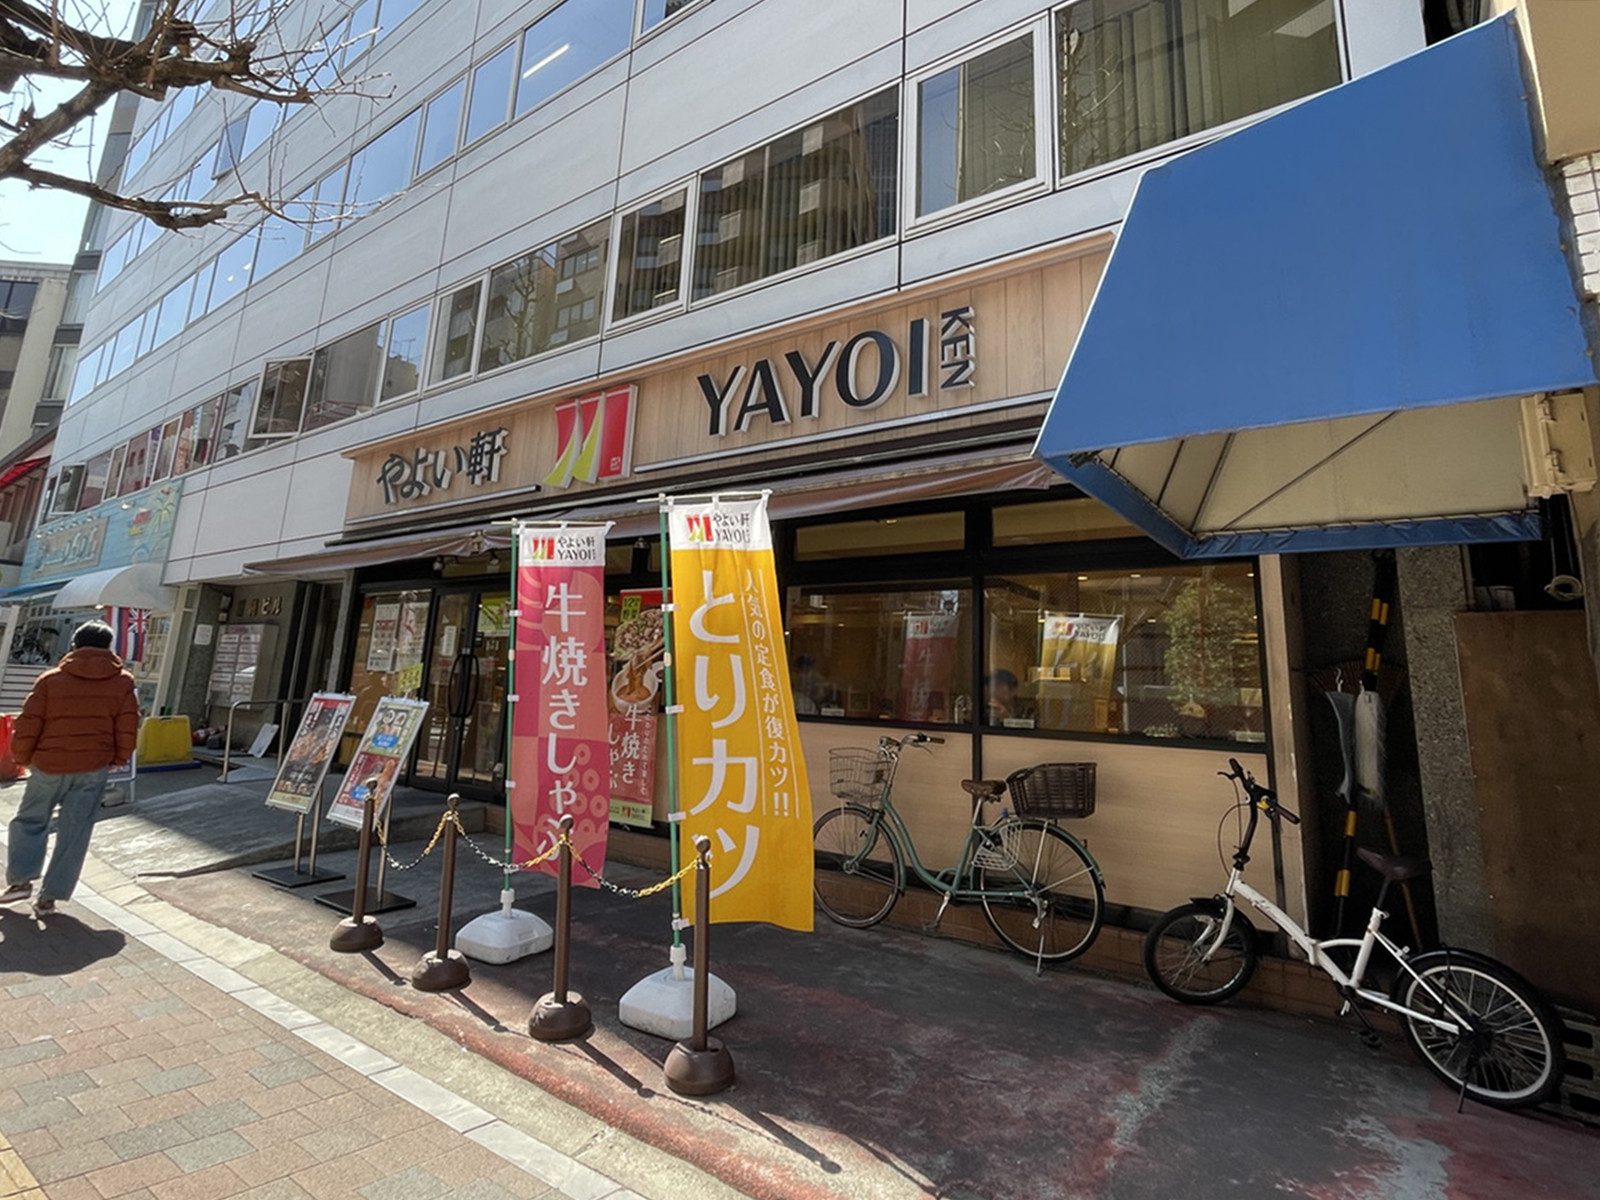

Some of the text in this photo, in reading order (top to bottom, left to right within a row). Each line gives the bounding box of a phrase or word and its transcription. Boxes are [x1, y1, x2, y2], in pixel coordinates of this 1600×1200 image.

[696, 305, 976, 437] YAYOI KEN
[376, 426, 510, 505] やよい軒
[557, 536, 595, 548] やよい軒
[557, 549, 591, 560] YAYOI
[620, 703, 643, 785] 牛焼き
[689, 569, 761, 899] とりカツ
